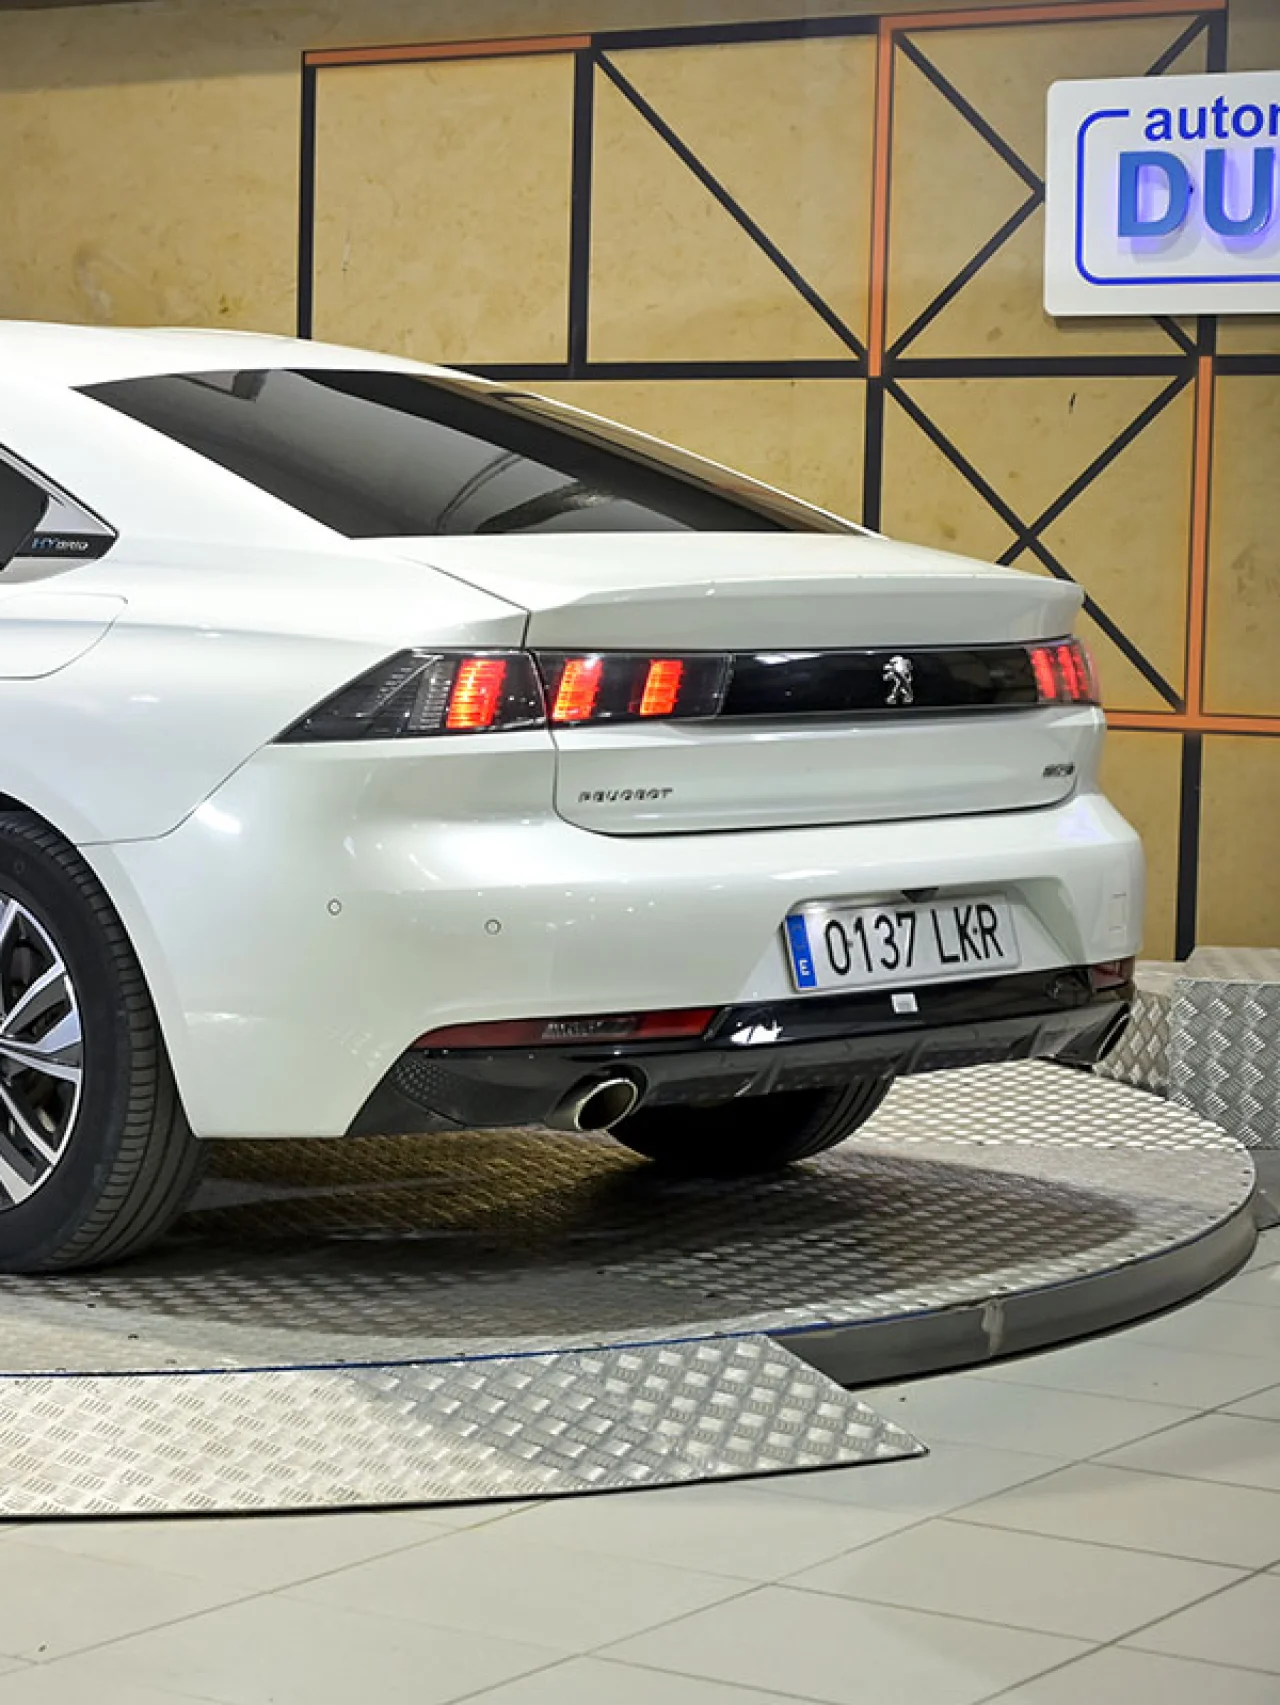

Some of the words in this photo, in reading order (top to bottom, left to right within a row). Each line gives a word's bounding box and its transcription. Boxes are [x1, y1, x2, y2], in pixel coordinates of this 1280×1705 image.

[1144, 96, 1280, 141] auto
[1117, 147, 1275, 238] DU
[578, 787, 673, 803] PEUGEOT
[825, 911, 916, 976] 0137
[930, 902, 1004, 965] LKR
[799, 958, 811, 976] E
